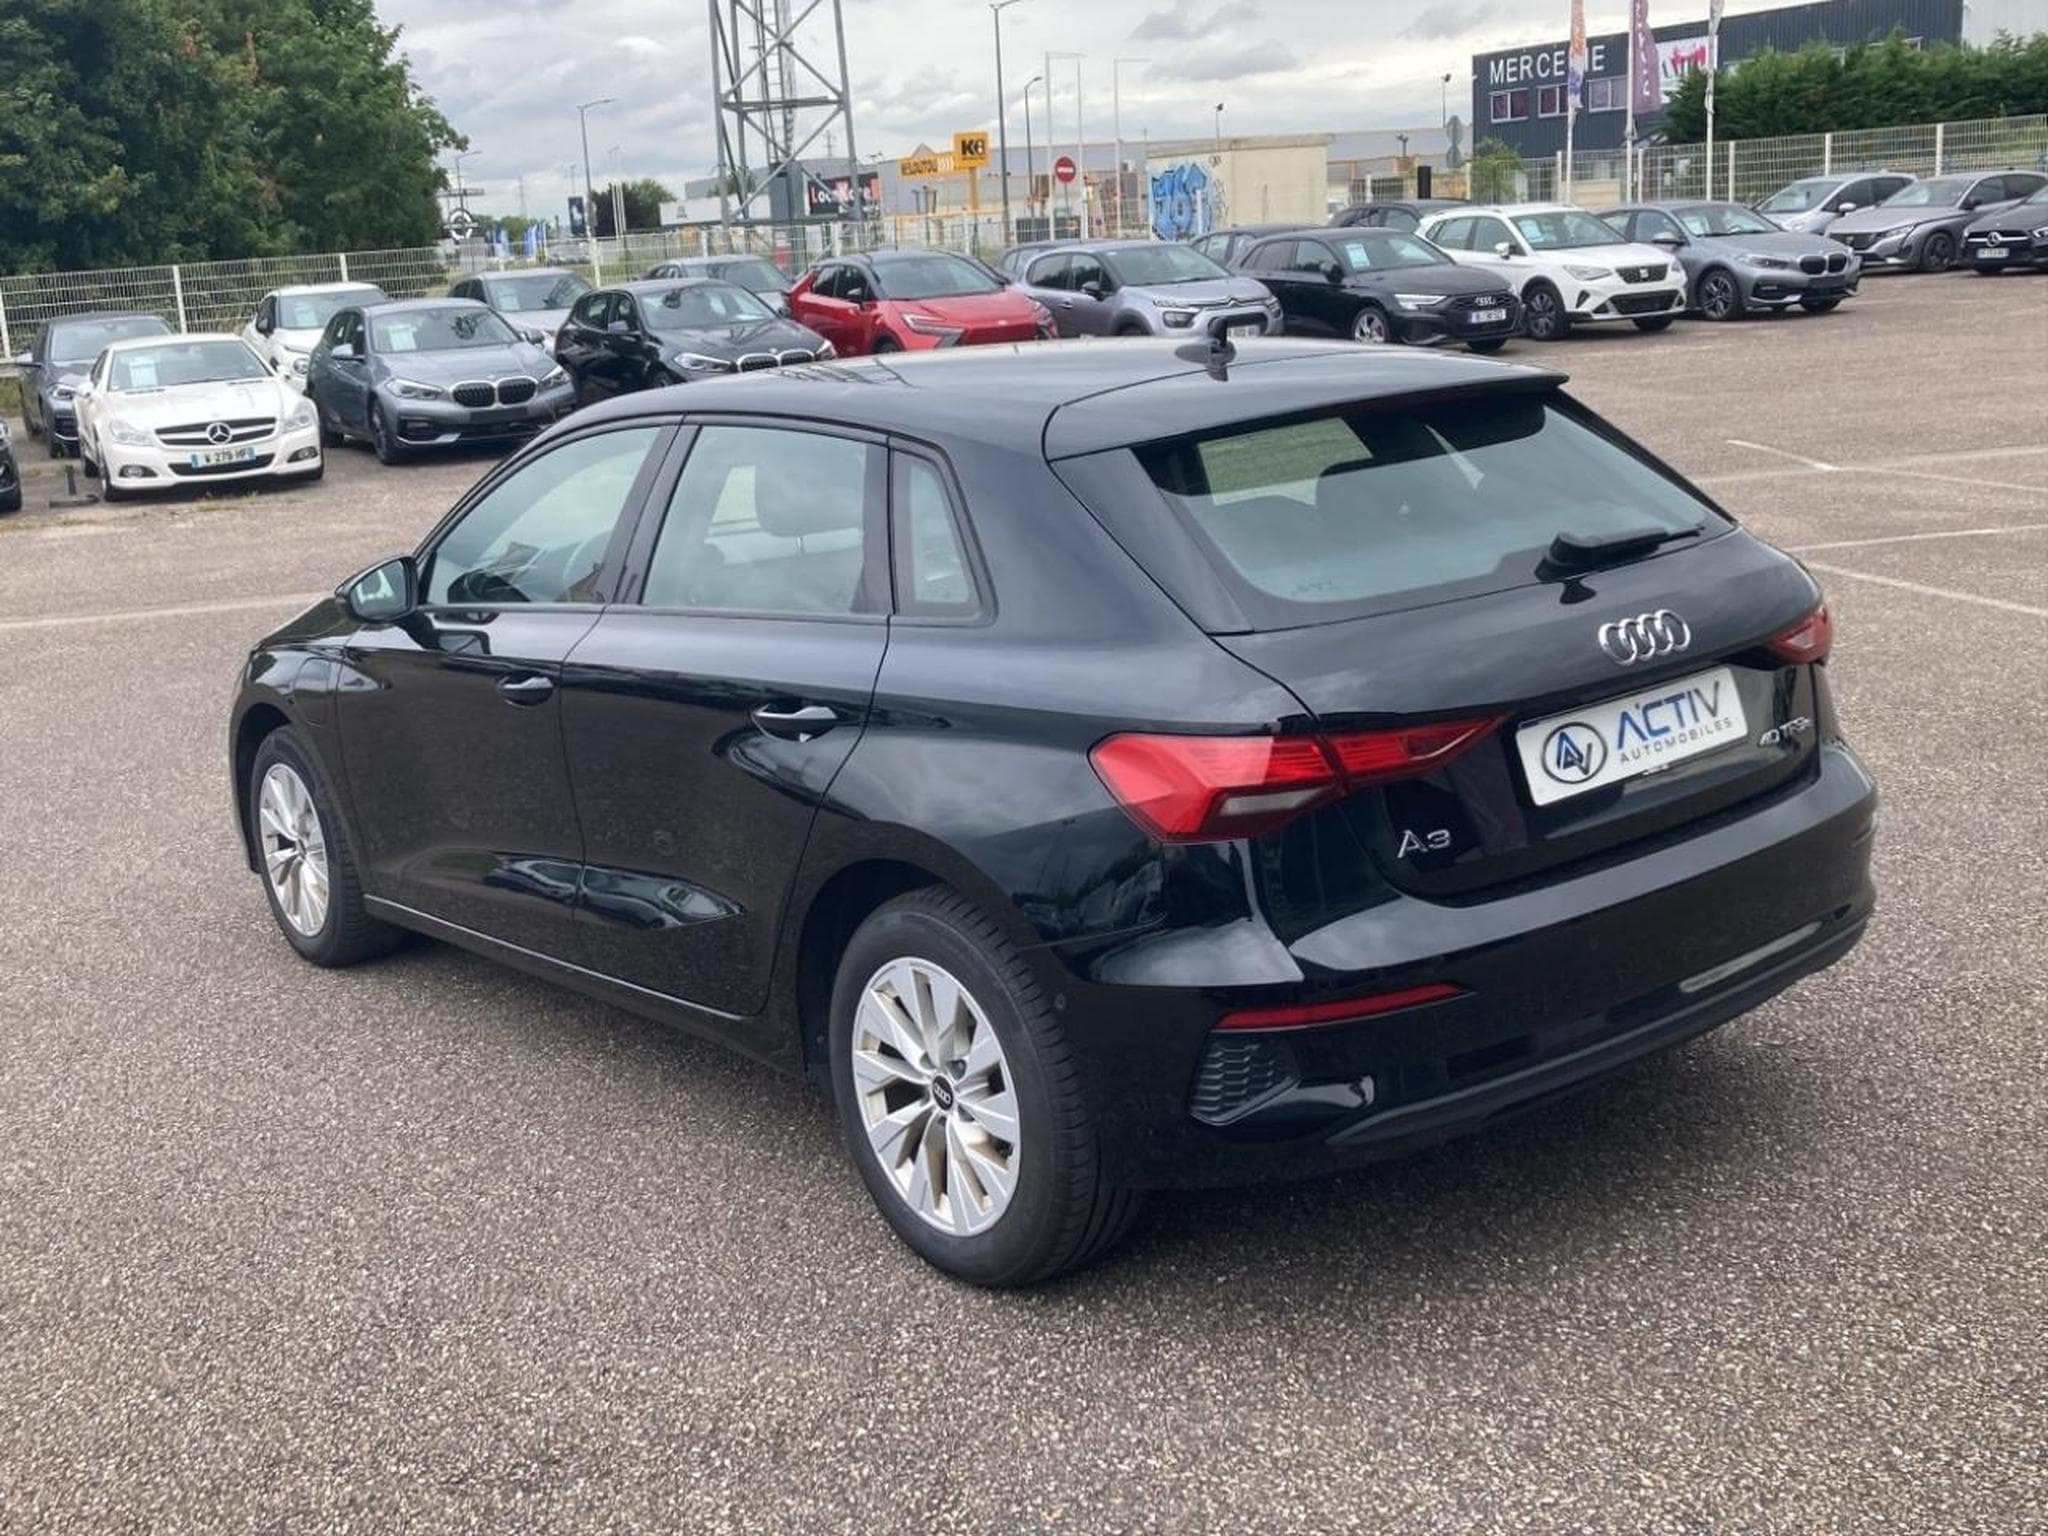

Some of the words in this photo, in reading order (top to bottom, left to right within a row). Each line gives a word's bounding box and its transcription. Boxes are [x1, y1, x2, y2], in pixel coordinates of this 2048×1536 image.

[1489, 45, 1605, 84] MERCEIE
[1620, 717, 1732, 764] AUTOMOBILES
[1397, 829, 1451, 858] A3
